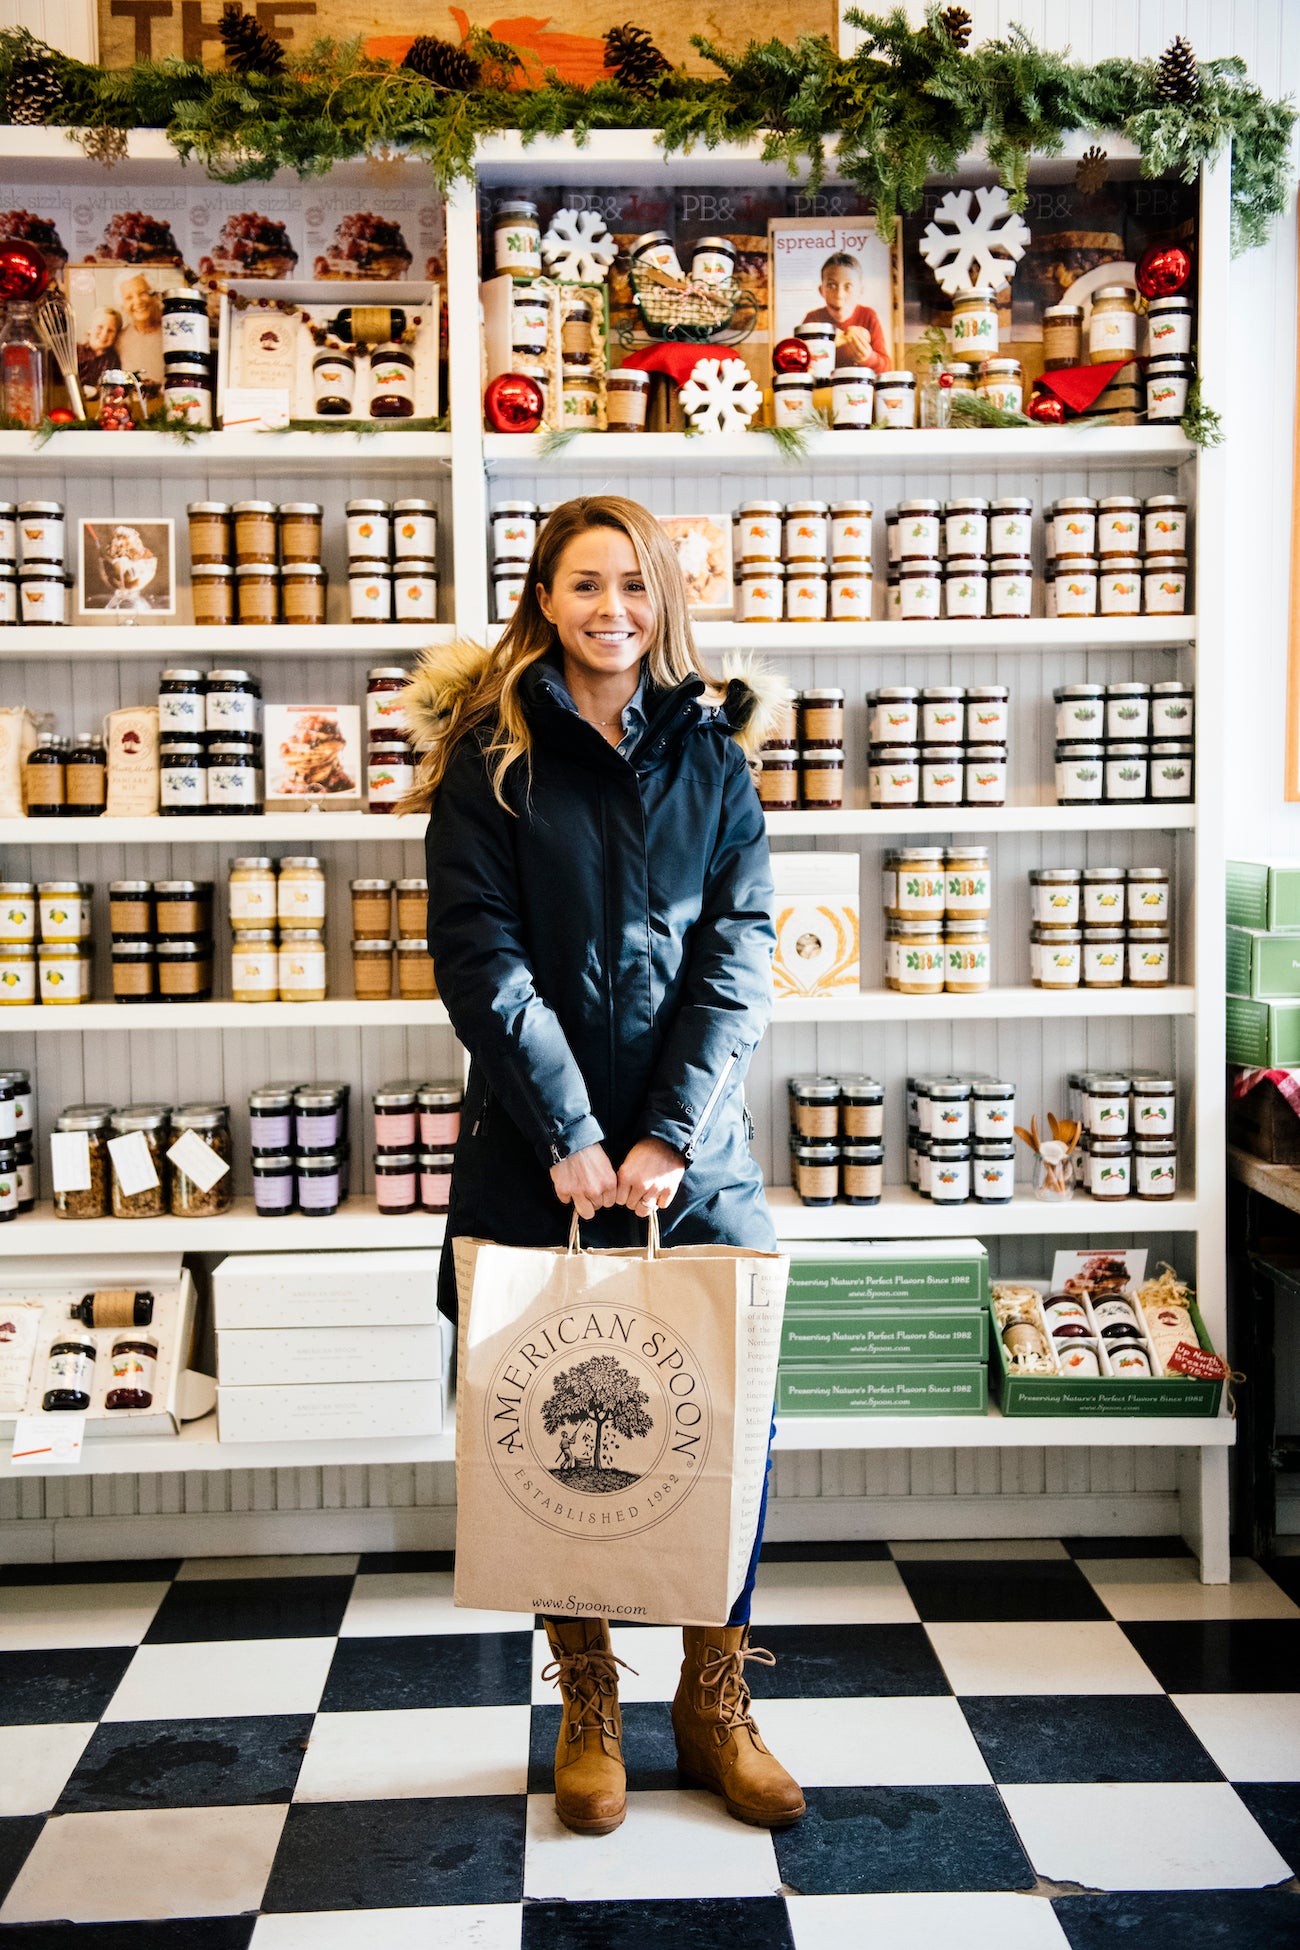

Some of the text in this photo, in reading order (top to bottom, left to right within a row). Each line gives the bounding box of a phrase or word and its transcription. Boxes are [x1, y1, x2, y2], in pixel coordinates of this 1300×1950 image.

[777, 231, 868, 253] spread joy
[788, 1274, 970, 1288] Preserving Nature's Perfect Flavors Since 1982
[848, 1288, 908, 1299] www.Spoon.com
[789, 1330, 972, 1343] Preserving Nature's Perfect Flavors Since 1982
[850, 1343, 910, 1354] www.Spoon.com
[494, 1312, 636, 1454] AMERICAN
[641, 1331, 703, 1461] SPOON
[789, 1384, 972, 1396] Preserving Nature's Perfect Flavors Since 1982
[850, 1397, 910, 1408] www.Spoon.com
[1018, 1393, 1061, 1403] Preserving
[1062, 1394, 1096, 1402] Nature's
[1098, 1394, 1126, 1402] Perfect
[1127, 1394, 1158, 1402] Flavors
[514, 1468, 680, 1525] ESTABLISHED 1982
[532, 1594, 648, 1616] www.Spoon.com
